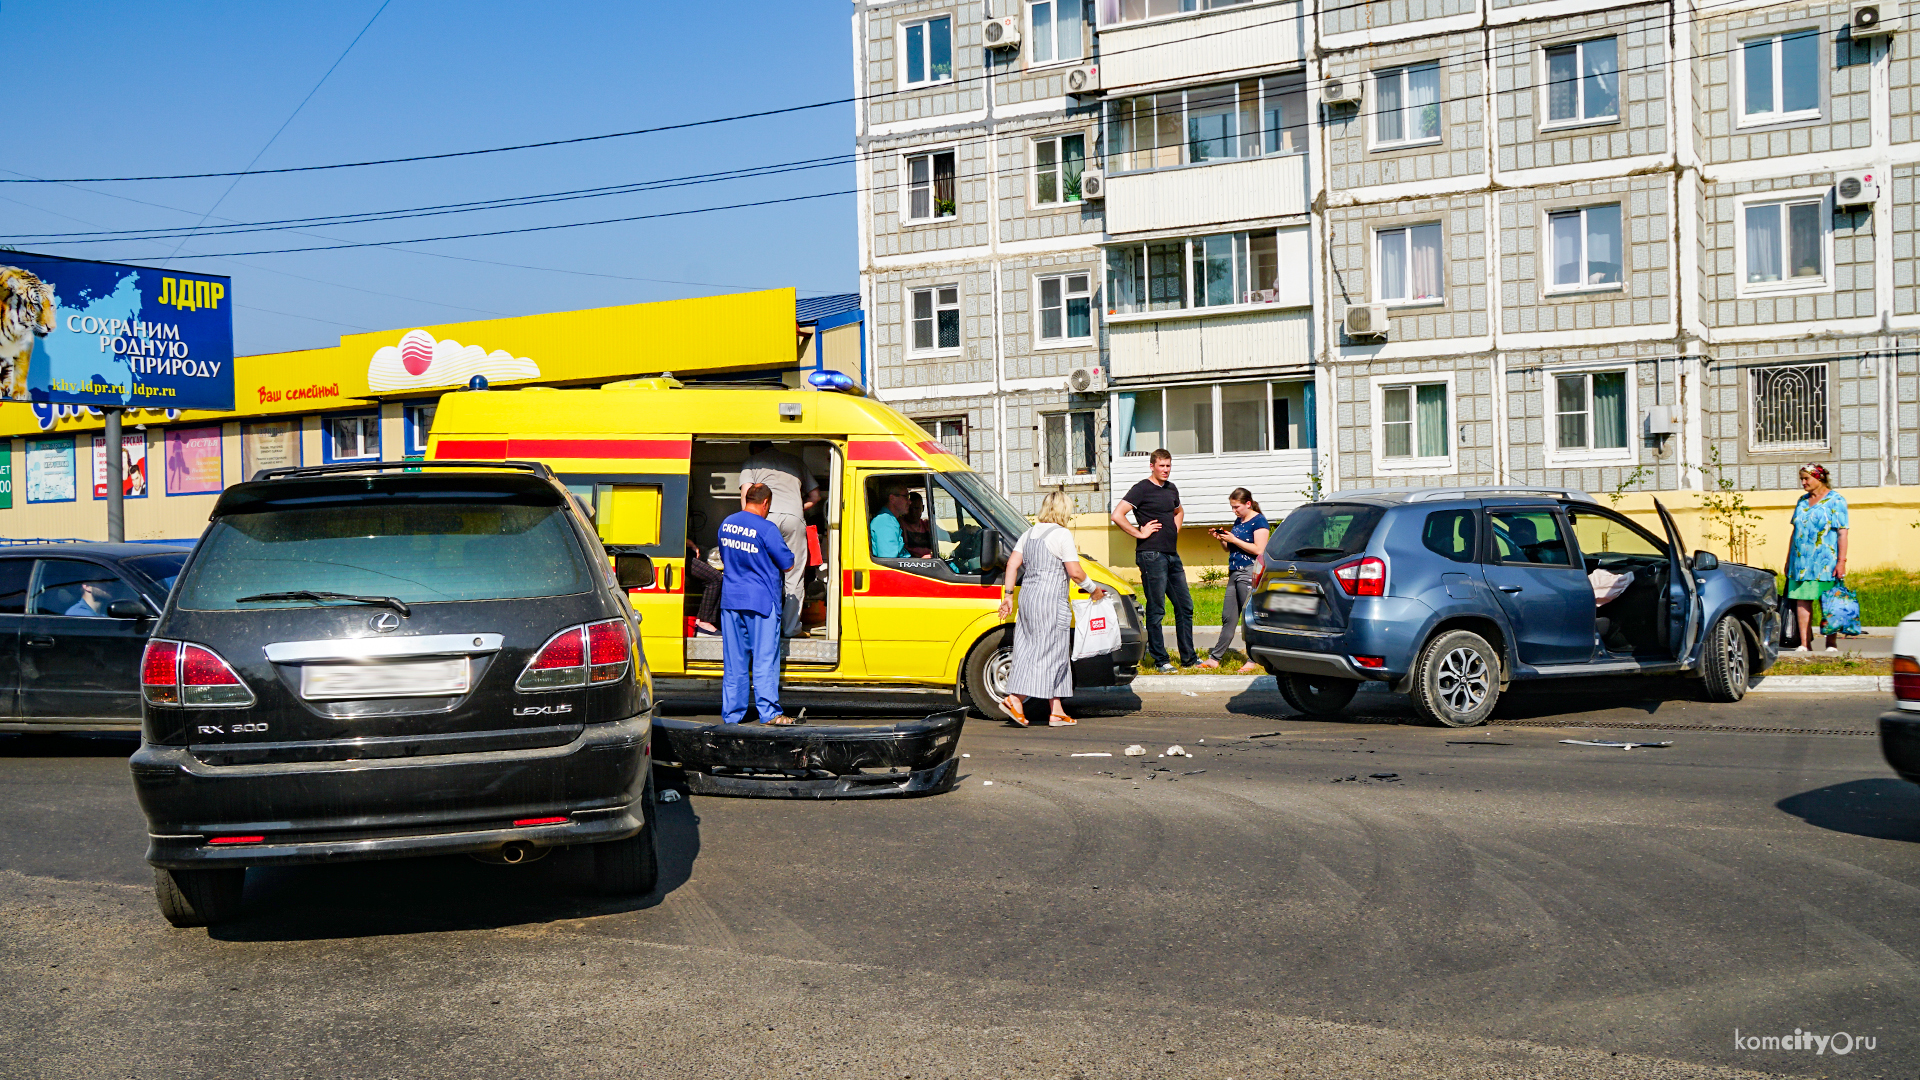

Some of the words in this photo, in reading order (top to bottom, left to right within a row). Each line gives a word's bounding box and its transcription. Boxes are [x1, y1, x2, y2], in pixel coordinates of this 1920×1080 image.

[158, 276, 225, 312] ЛДПР
[66, 314, 181, 341] СОХРАНИМ
[100, 336, 189, 359] РОДНУЮ
[130, 356, 222, 378] ПРИРОДУ
[52, 378, 130, 397] khv.ldpr.ru,
[133, 385, 177, 398] ldpr.ru
[257, 386, 282, 405] Ваш
[285, 382, 340, 401] семейный
[185, 439, 219, 449] ГОСТЬЯ
[722, 523, 757, 538] СКОРАЯ
[512, 704, 573, 716] LEXUS
[197, 725, 225, 734] RX
[231, 722, 269, 733] 300
